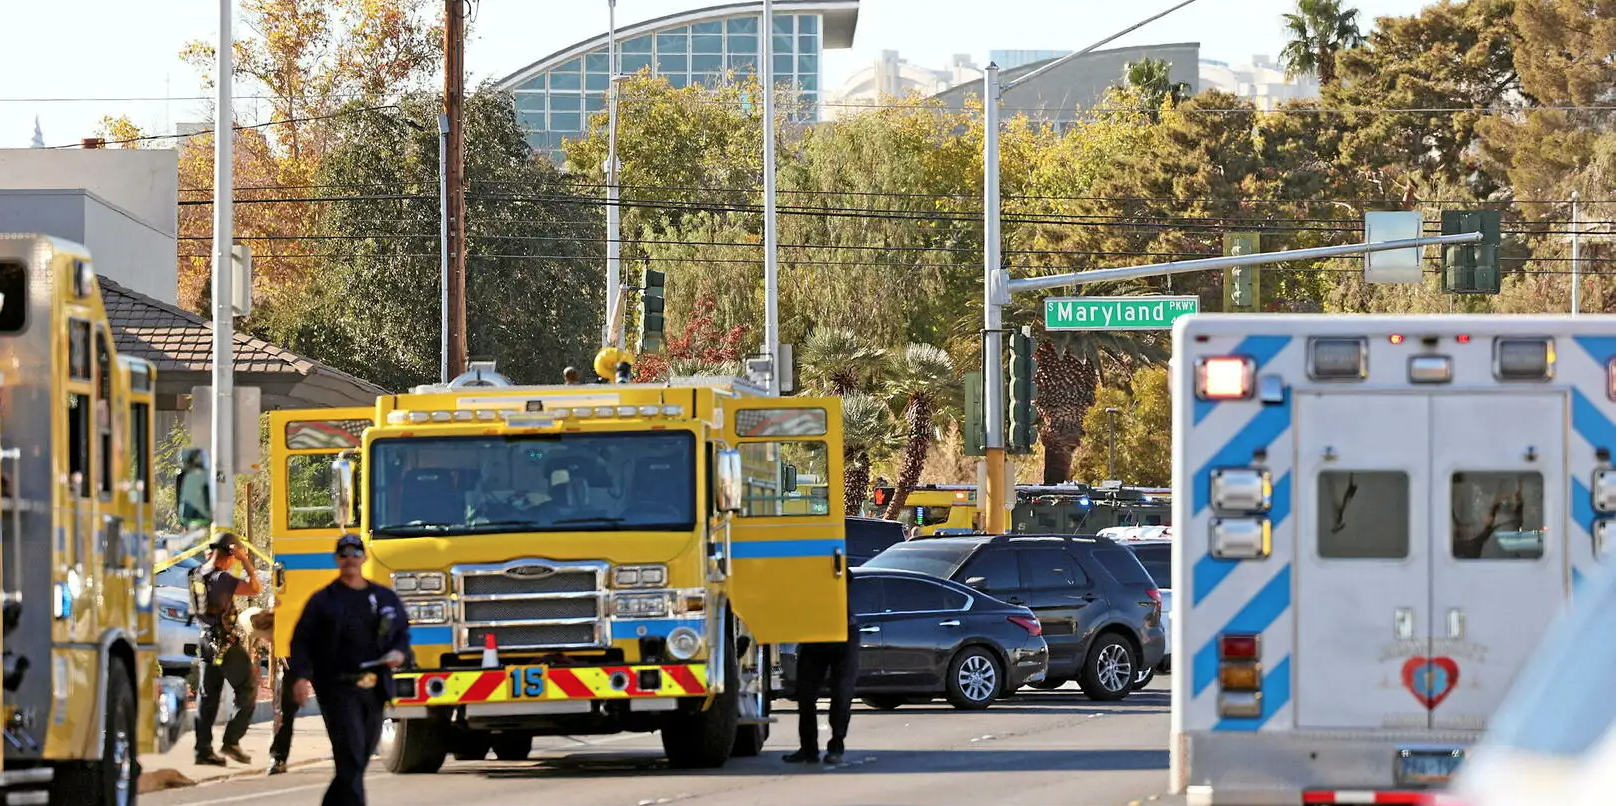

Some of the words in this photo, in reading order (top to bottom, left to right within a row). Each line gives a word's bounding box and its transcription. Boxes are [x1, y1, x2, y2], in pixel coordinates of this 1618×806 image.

[1048, 303, 1054, 312] S
[1057, 302, 1164, 326] Maryland
[1169, 301, 1194, 311] PKWY
[510, 667, 544, 697] 15
